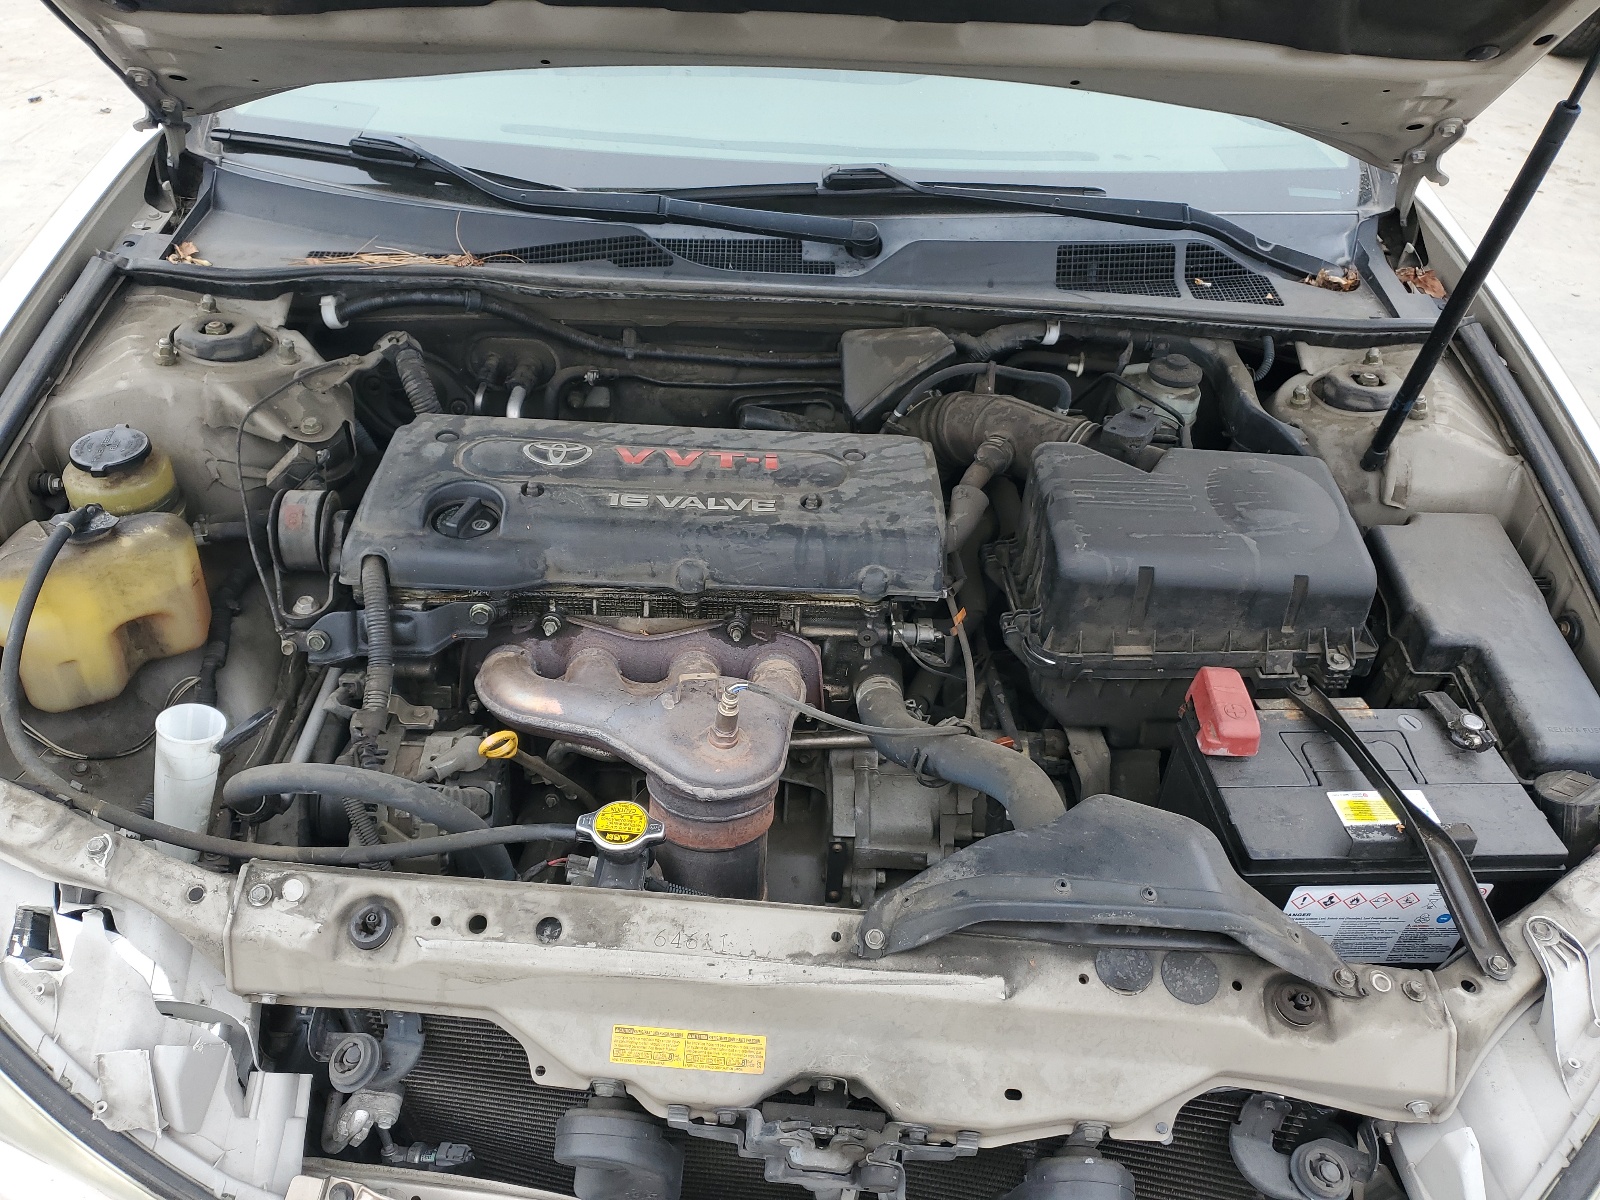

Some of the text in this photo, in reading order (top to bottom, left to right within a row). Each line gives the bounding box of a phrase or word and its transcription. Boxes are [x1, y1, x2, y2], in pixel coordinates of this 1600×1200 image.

[616, 448, 778, 470] VVT-i
[608, 493, 776, 512] 16 VALVE
